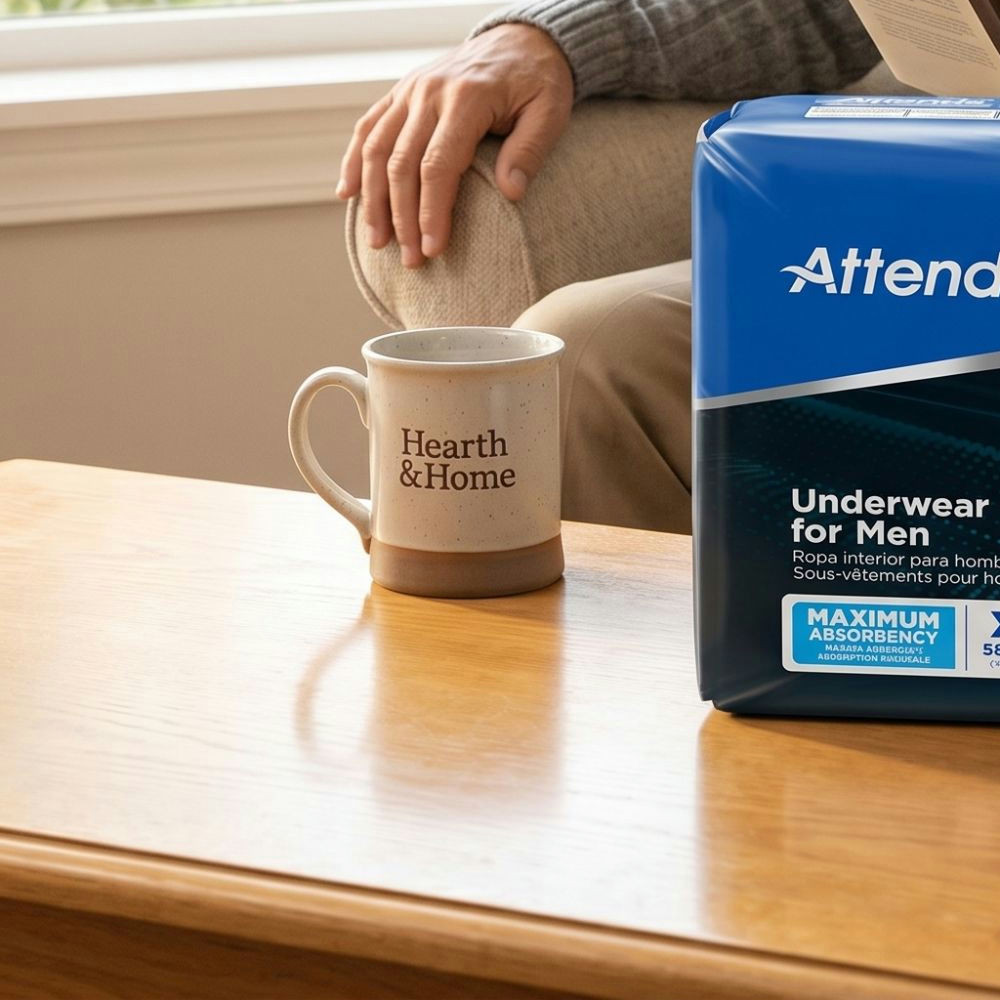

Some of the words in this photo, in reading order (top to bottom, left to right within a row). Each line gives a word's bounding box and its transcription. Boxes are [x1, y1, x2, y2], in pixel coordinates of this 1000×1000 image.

[401, 428, 508, 459] Hearth
[791, 488, 989, 518] Underwear
[791, 517, 842, 544] for
[857, 519, 930, 546] Men
[793, 550, 837, 565] Ropa
[843, 551, 905, 567] interior
[910, 556, 949, 569] para
[793, 566, 933, 583] Sous-vêtements
[937, 573, 978, 587] pour
[808, 608, 939, 629] MAXIMUM
[809, 628, 938, 645] ABSORBENCY
